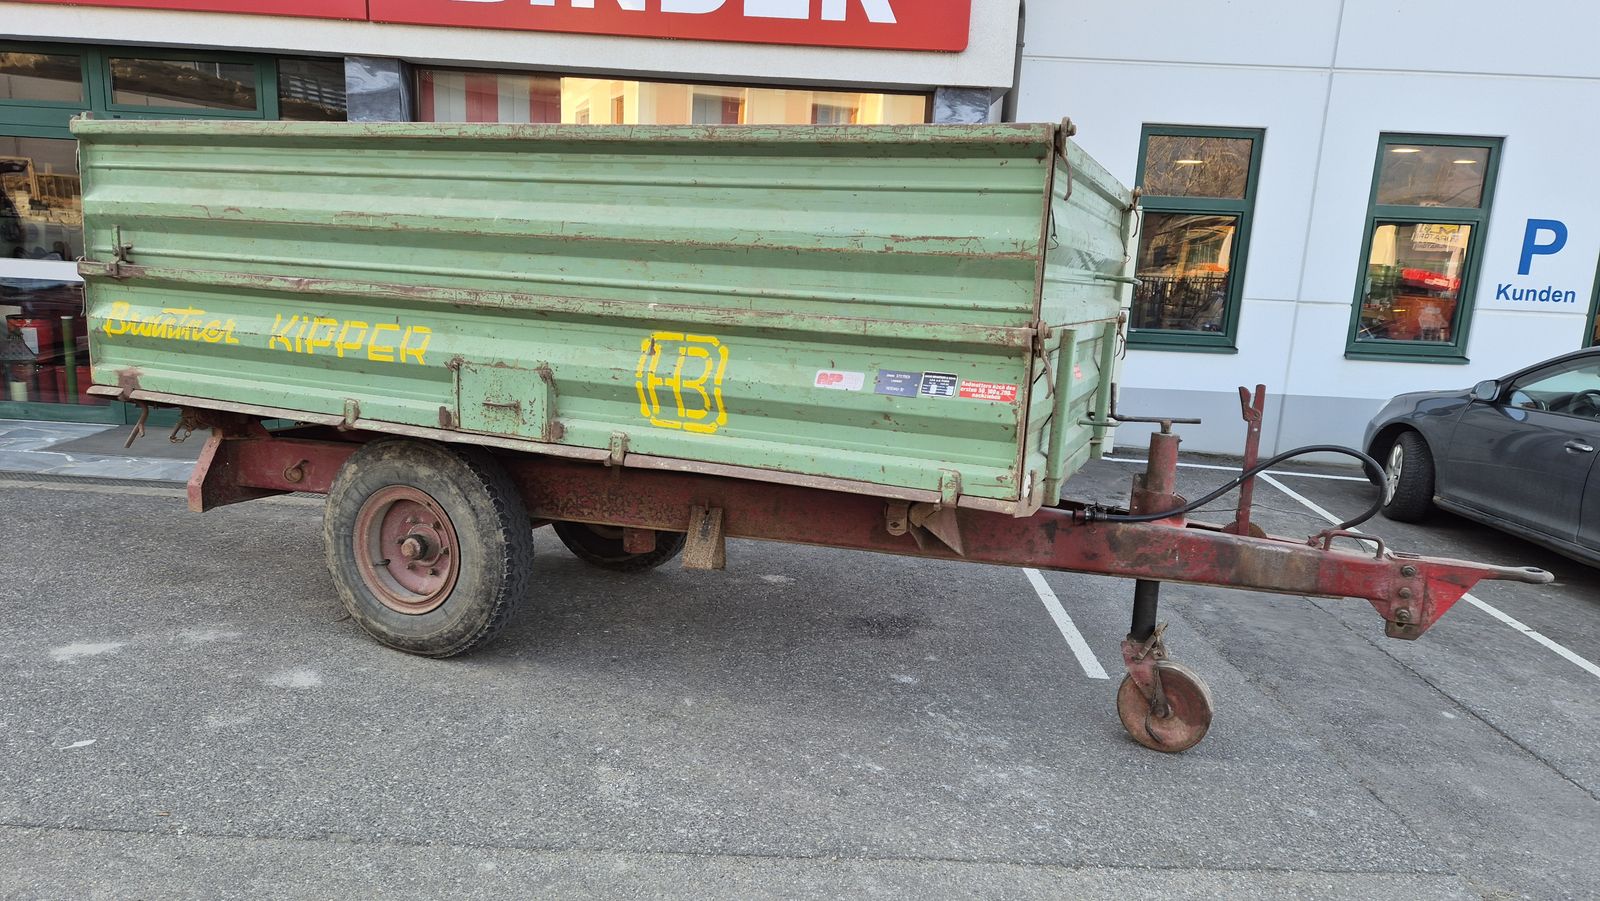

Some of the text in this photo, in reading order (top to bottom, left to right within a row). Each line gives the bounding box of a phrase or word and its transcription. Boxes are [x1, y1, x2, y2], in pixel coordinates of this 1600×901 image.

[1517, 218, 1568, 275] P
[1495, 283, 1576, 303] Kunden
[268, 313, 433, 365] KIPPER
